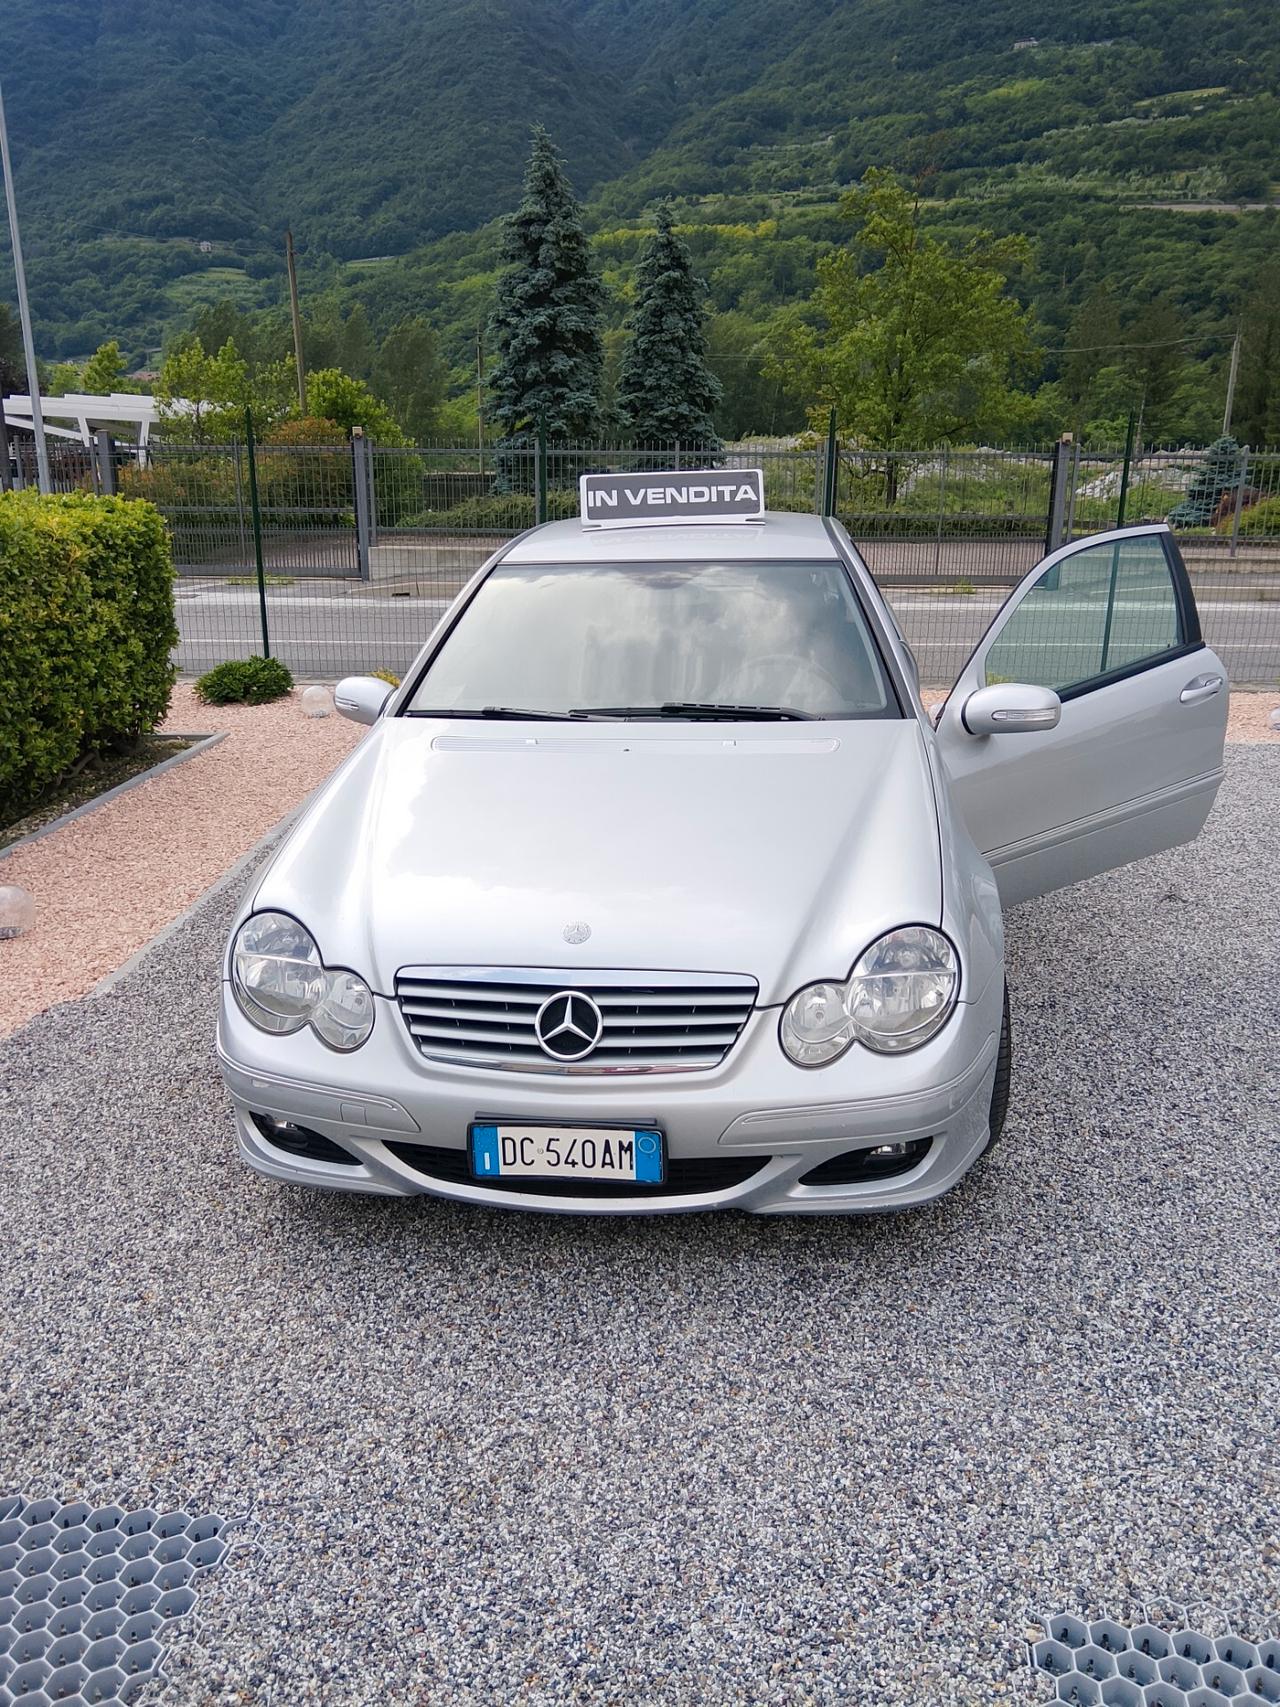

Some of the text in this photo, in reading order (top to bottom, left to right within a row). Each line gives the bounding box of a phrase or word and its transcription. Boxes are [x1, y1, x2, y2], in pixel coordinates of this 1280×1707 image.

[588, 485, 758, 507] IN VENDITA
[484, 1152, 491, 1170] I
[501, 1136, 634, 1170] DC 540AM
